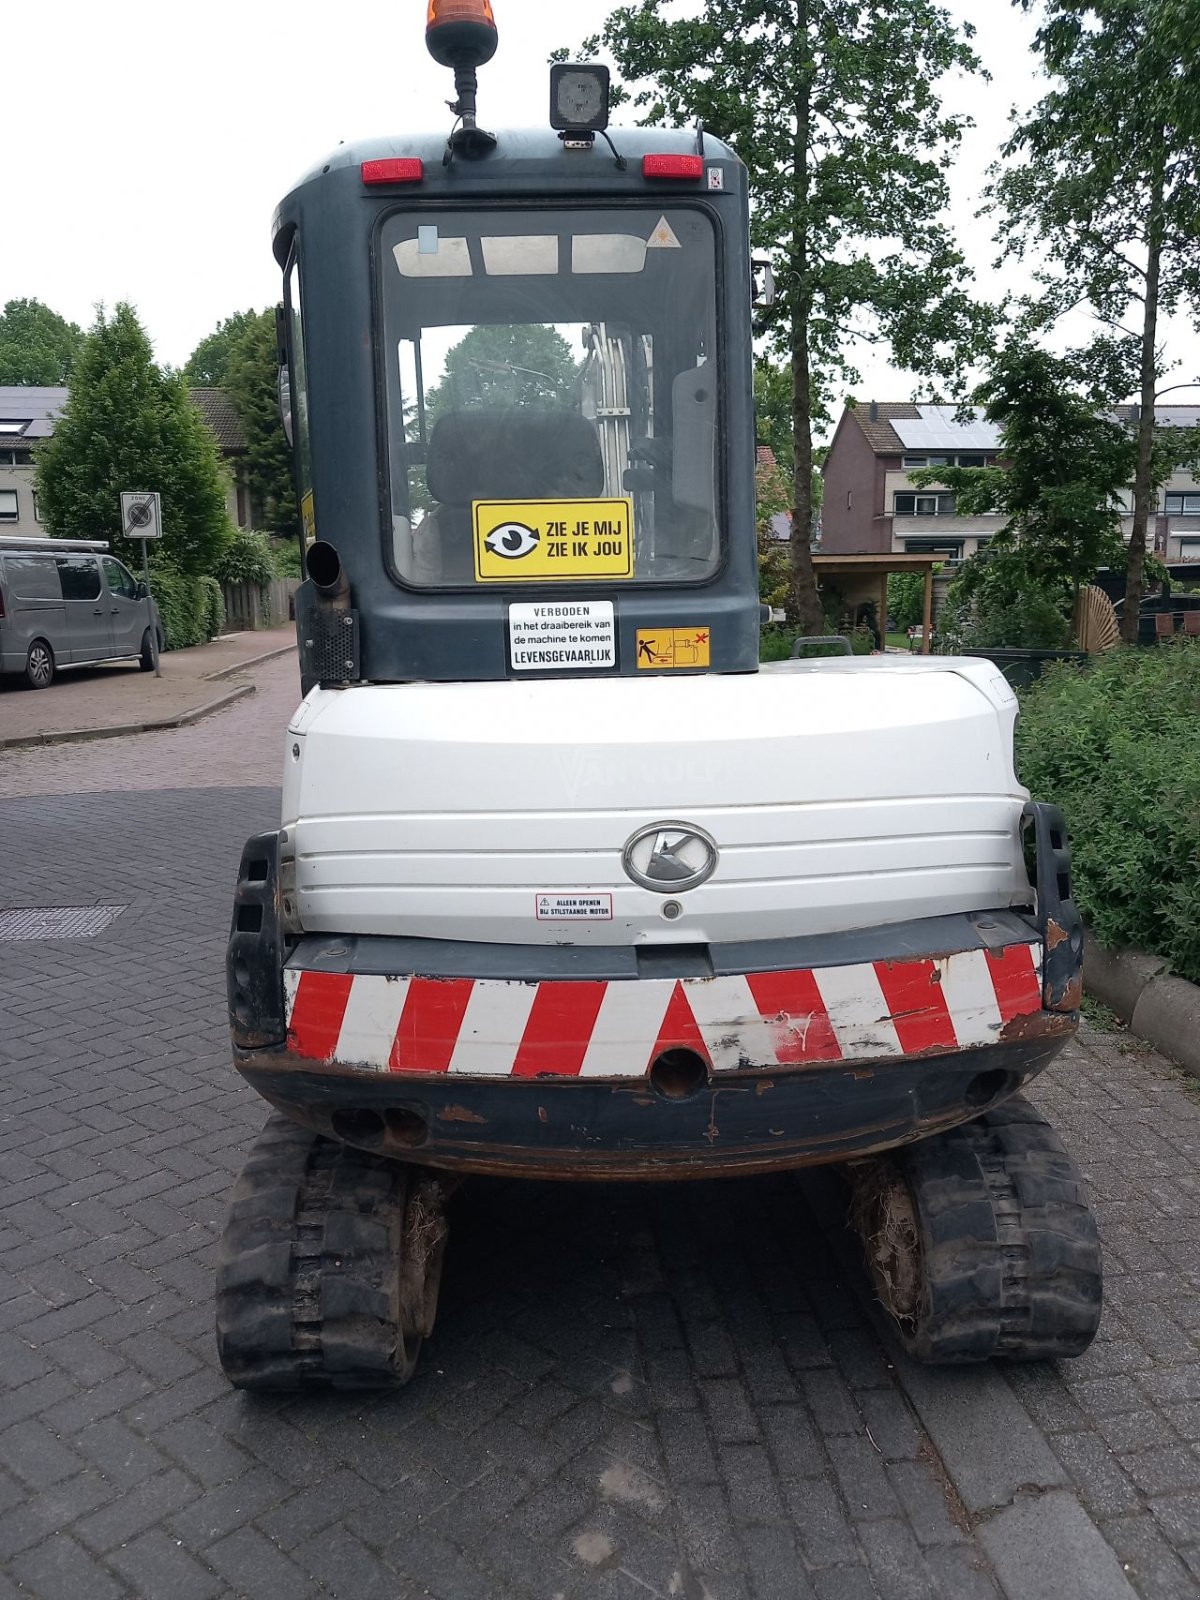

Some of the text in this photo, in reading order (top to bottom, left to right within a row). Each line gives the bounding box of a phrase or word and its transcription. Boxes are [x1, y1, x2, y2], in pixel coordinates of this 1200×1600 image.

[546, 520, 622, 537] ZIE JE MIJ
[547, 541, 622, 557] ZIE IK JOU
[534, 606, 590, 617] VERBODEN
[513, 622, 522, 631] in
[523, 622, 539, 631] het
[540, 620, 593, 630] draaibereik
[514, 634, 611, 645] de machine te komen
[514, 649, 612, 664] LEVENSGEVAARLIJK
